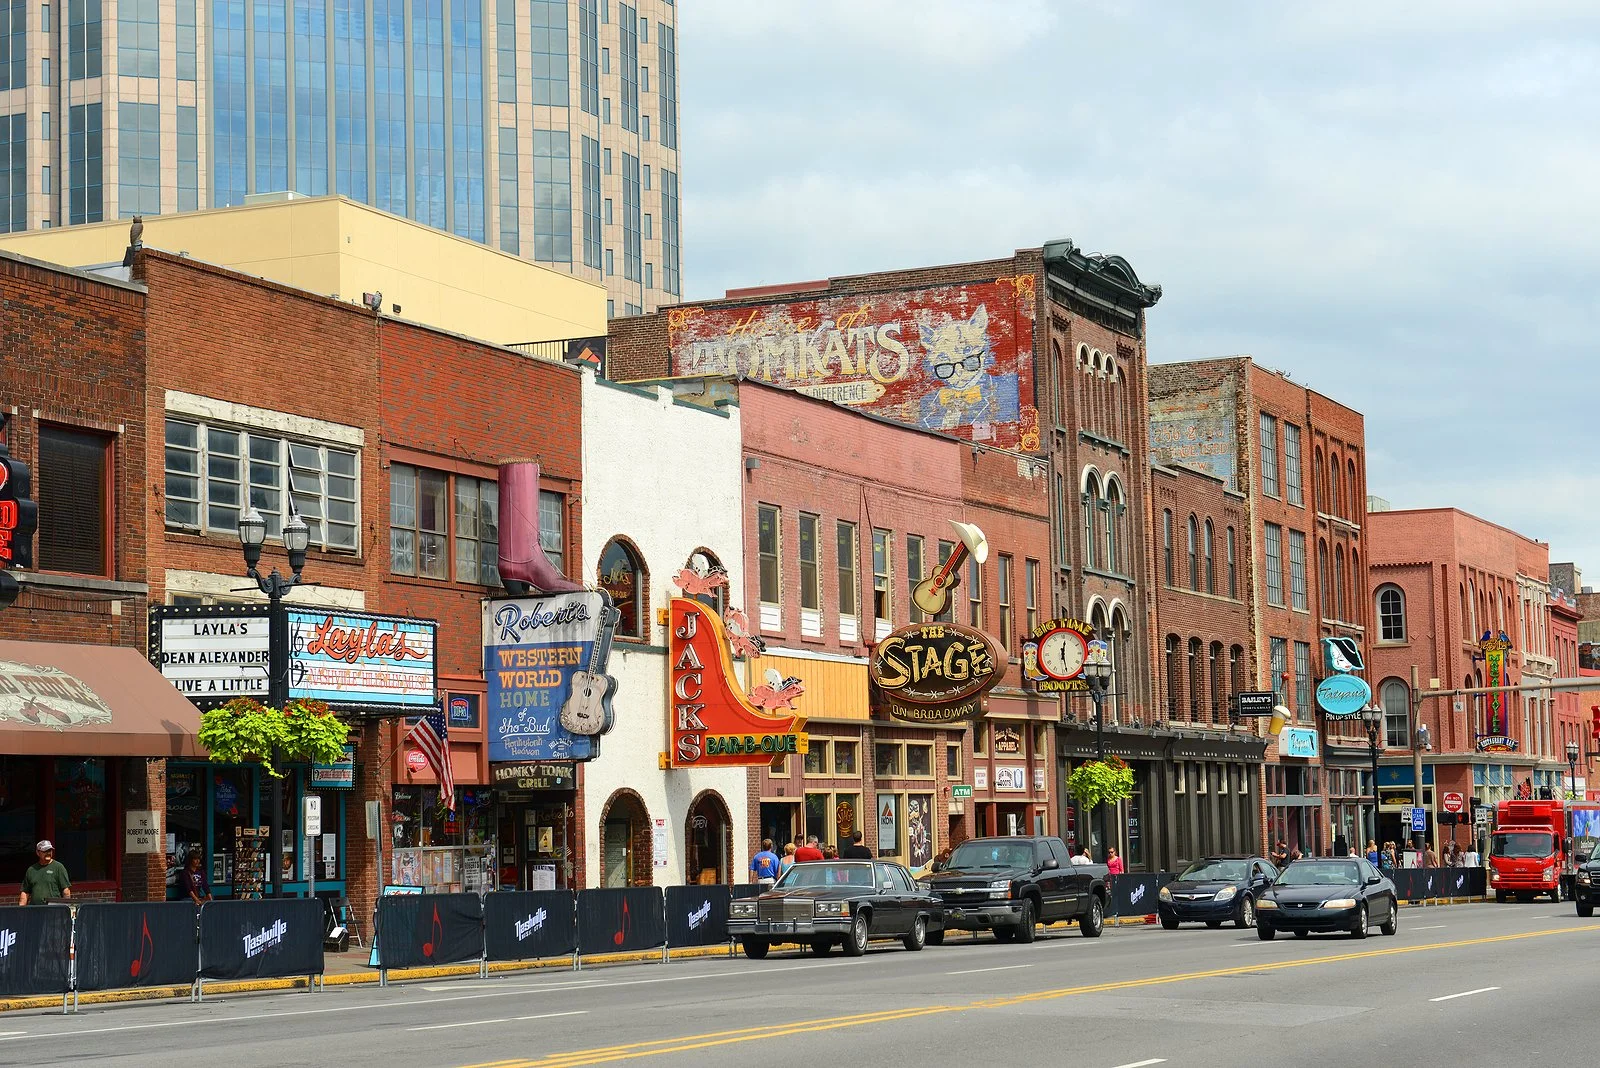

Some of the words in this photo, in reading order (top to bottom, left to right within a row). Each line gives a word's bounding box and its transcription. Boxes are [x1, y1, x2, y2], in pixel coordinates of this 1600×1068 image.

[837, 303, 872, 331] of
[692, 322, 910, 384] TOMKATS
[812, 383, 867, 402] DIFFERENCE
[194, 623, 248, 636] LAYLA'S
[495, 601, 592, 643] Robert's
[1033, 620, 1057, 637] BIG
[1059, 618, 1093, 636] TIME
[307, 614, 428, 664] Layla's
[921, 626, 945, 639] THE
[162, 652, 195, 664] DEAN
[199, 651, 269, 664] ALEXANDER
[498, 647, 583, 668] WESTERN
[878, 637, 993, 690] STAGE
[175, 680, 202, 691] LIVE
[208, 680, 217, 691] A
[222, 679, 263, 690] LITTLE
[498, 669, 563, 689] WORLD
[1038, 680, 1089, 691] BOOTS
[500, 690, 550, 708] HOME
[1241, 696, 1271, 704] BAILEY'S
[517, 707, 528, 721] of
[892, 704, 908, 717] ON
[913, 702, 977, 719] BROADWAY
[1325, 713, 1335, 721] PIN
[1344, 712, 1361, 720] STYLE
[498, 716, 550, 734] Sho-Bud
[706, 735, 798, 755] BAR-B-QUE
[552, 751, 570, 759] GRILL
[495, 765, 538, 780] HONKY
[540, 765, 574, 779] TONK
[518, 778, 550, 788] GRILL
[953, 788, 970, 796] ATM
[126, 828, 143, 836] ROBERT
[144, 828, 159, 836] MOORE
